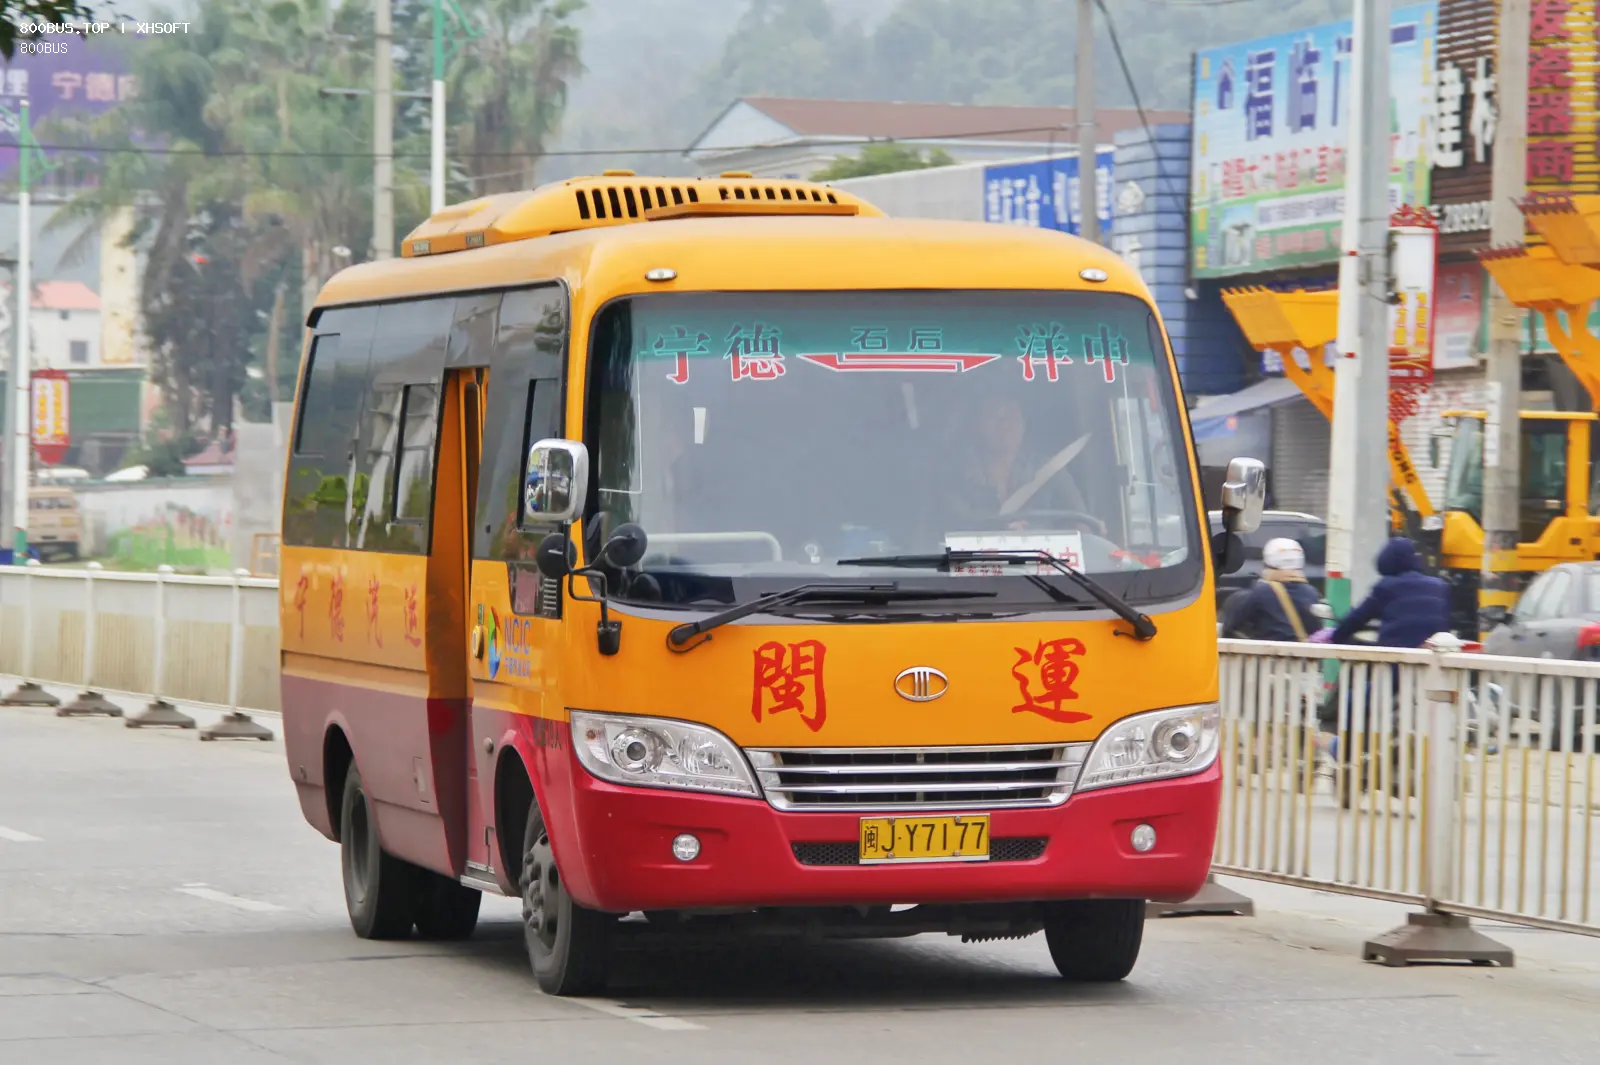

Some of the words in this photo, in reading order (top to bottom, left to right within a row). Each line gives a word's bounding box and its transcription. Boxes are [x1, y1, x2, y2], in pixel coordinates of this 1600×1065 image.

[653, 322, 786, 385] 宁德
[851, 325, 944, 353] 石后
[1015, 321, 1130, 384] 洋中
